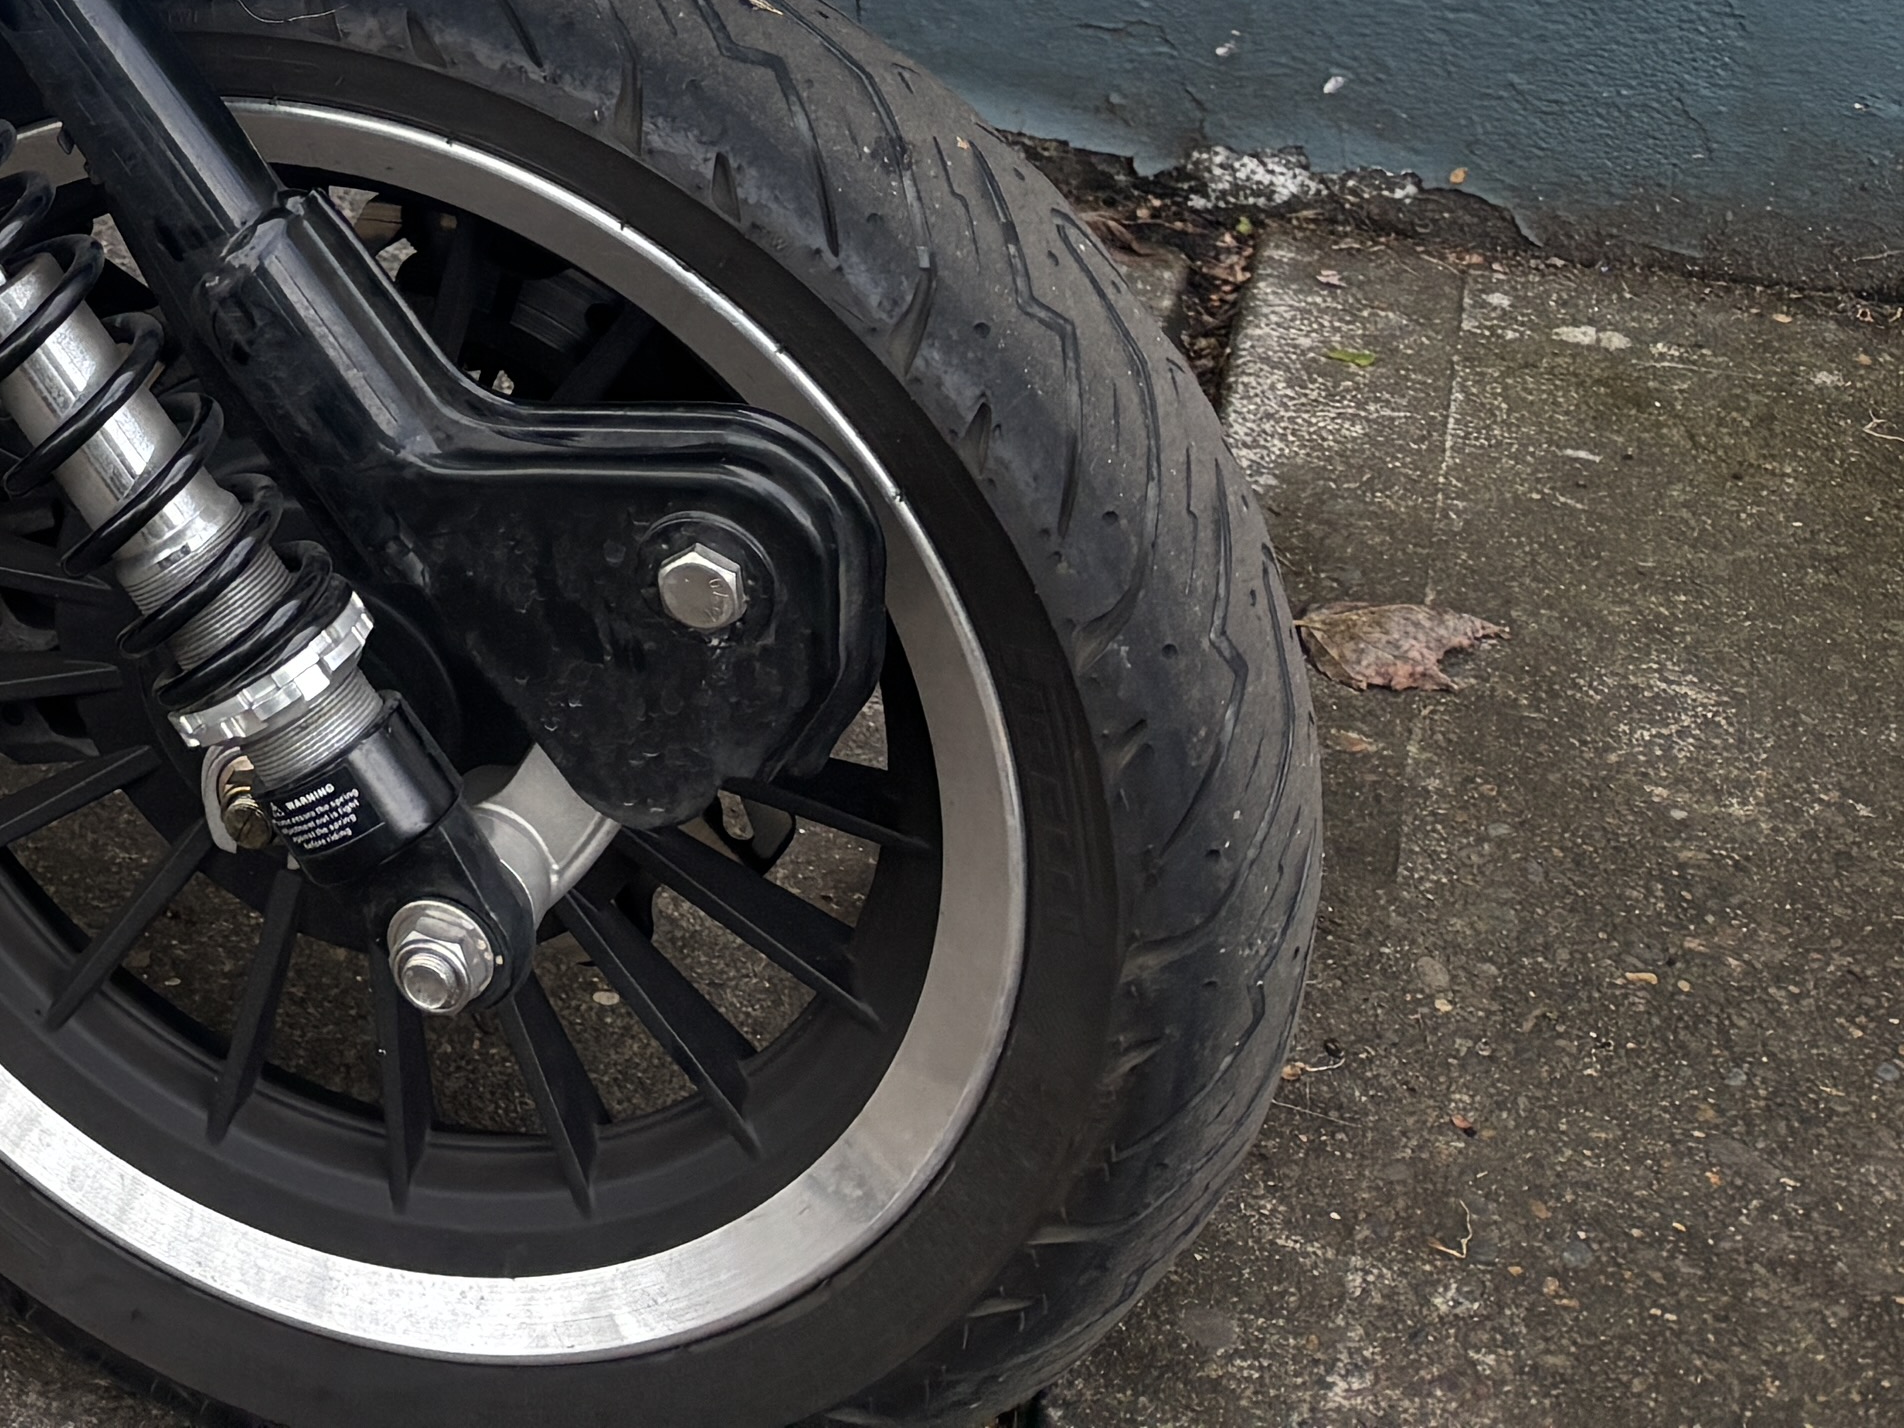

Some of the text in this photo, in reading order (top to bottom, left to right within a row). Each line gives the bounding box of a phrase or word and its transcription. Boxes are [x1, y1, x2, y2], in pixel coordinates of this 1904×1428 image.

[285, 783, 335, 810] WARNING
[330, 788, 360, 808] spring
[329, 813, 357, 831] spring
